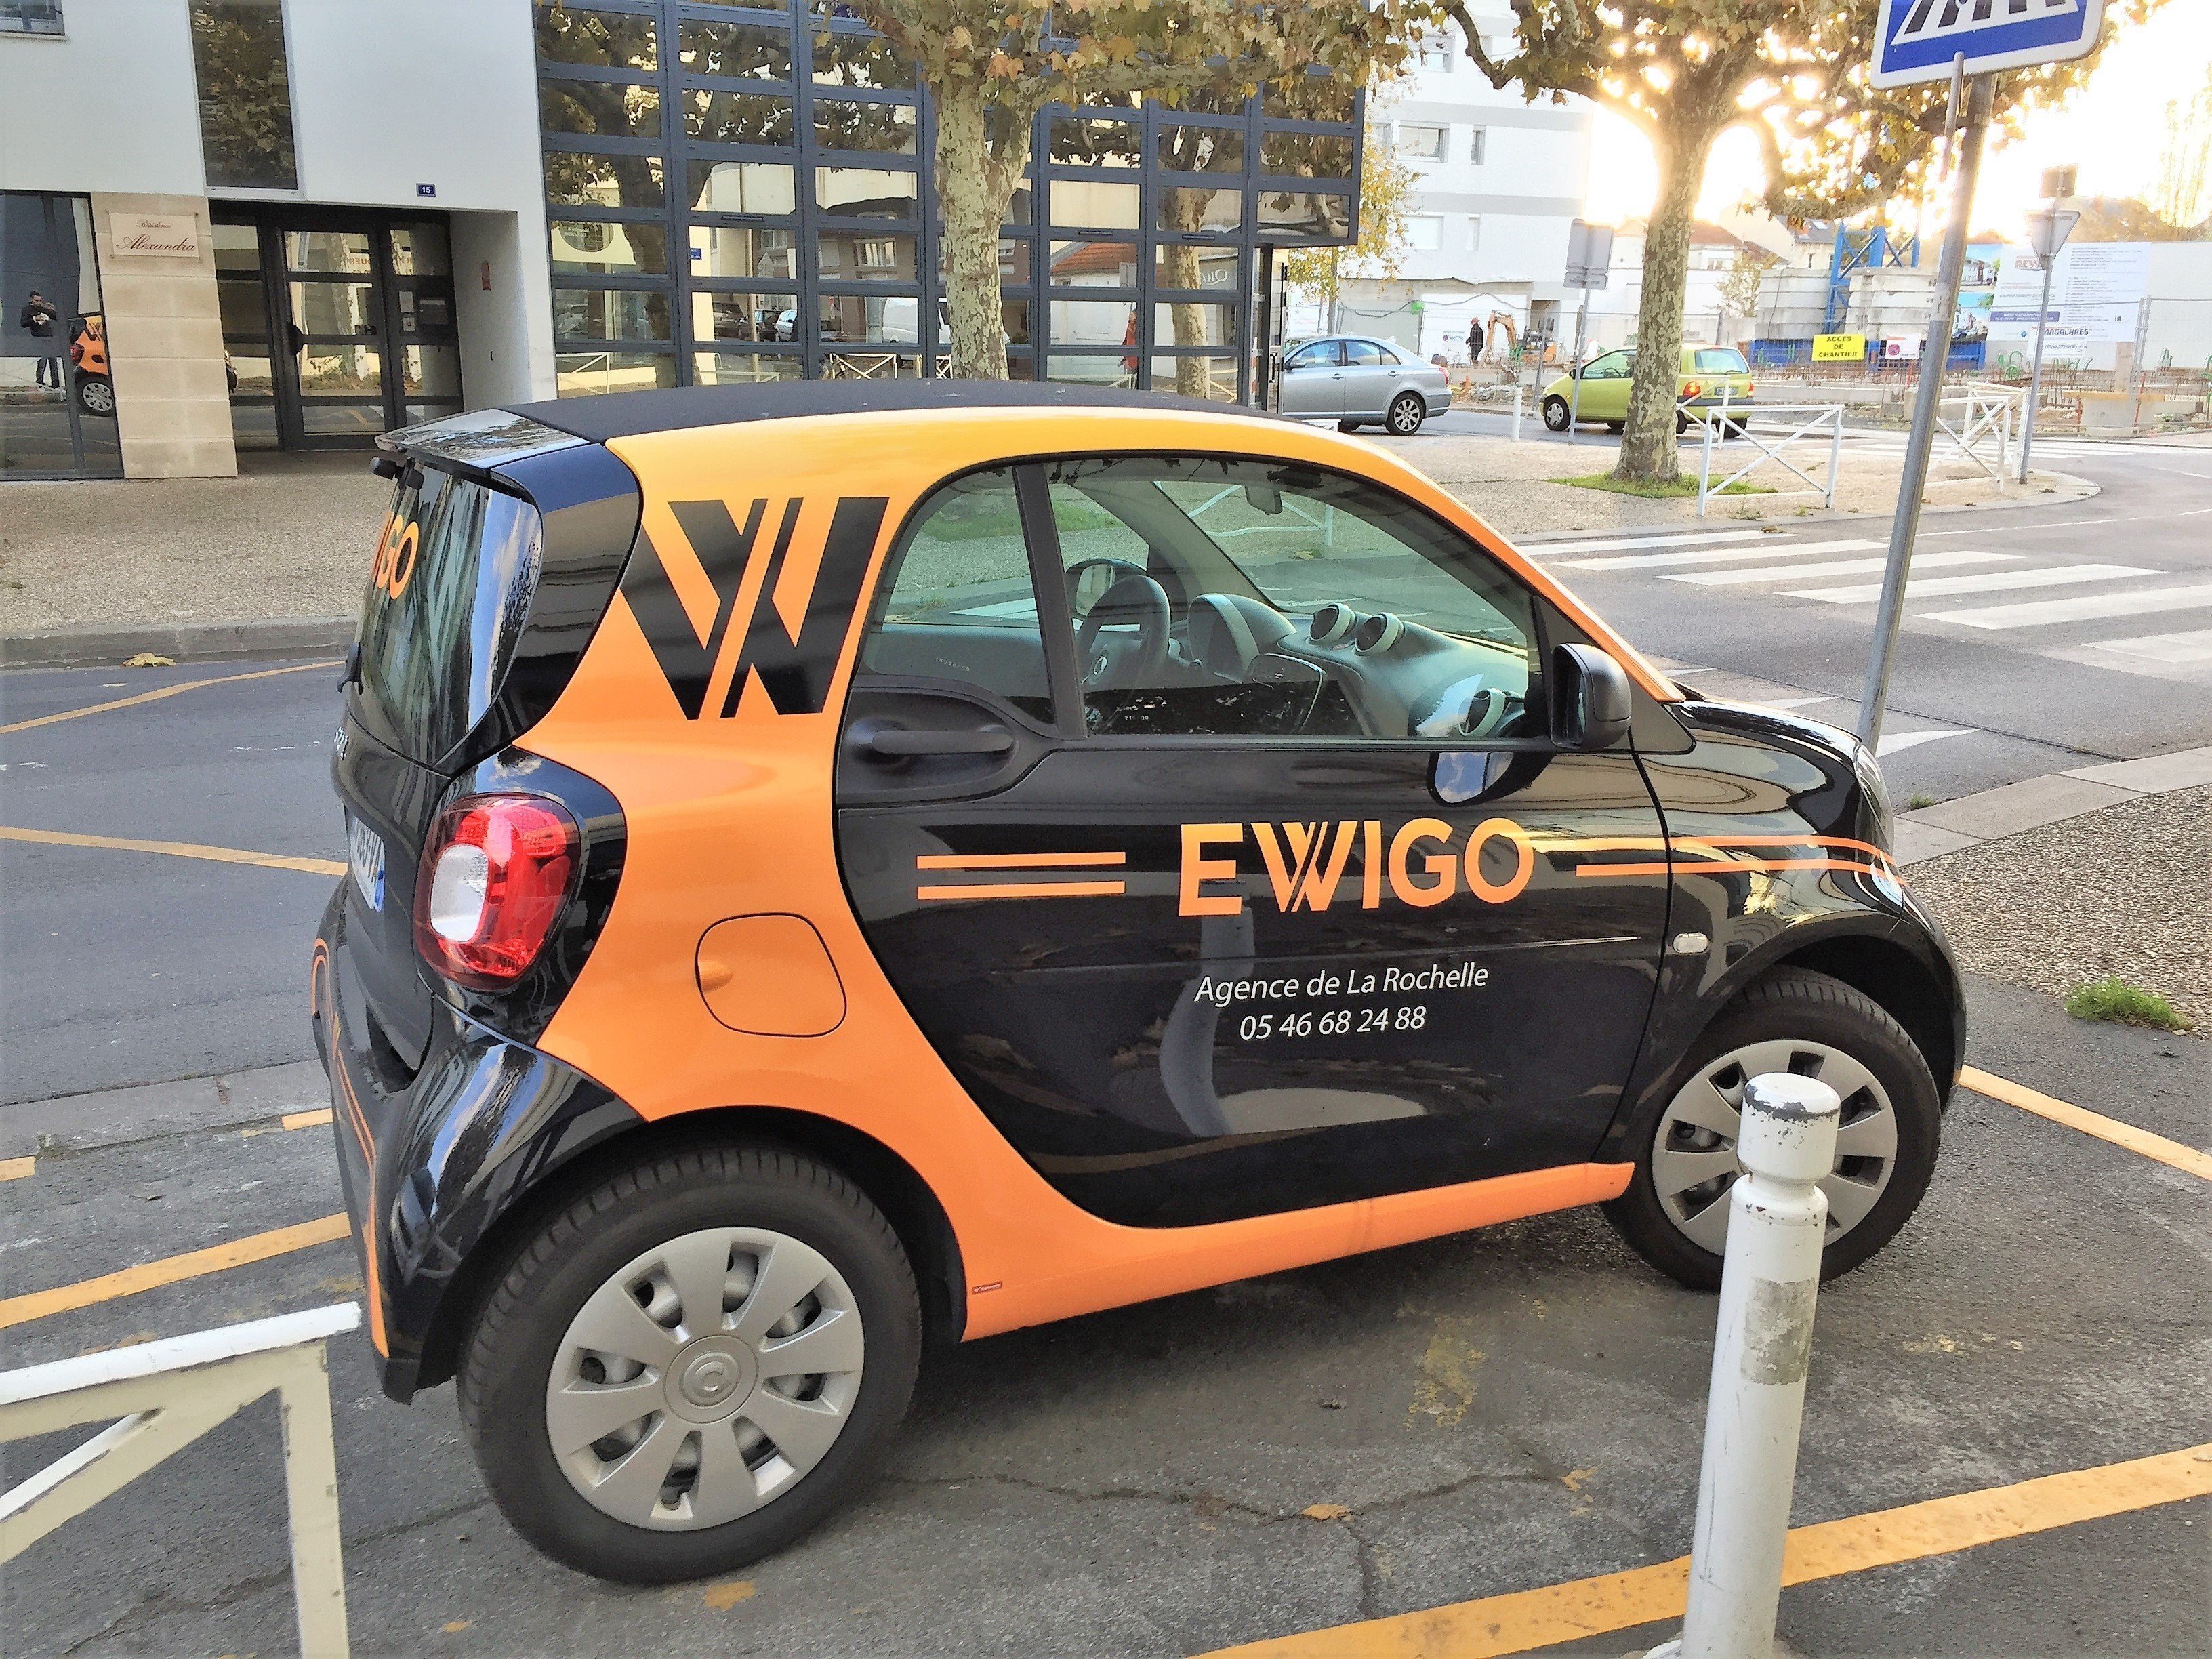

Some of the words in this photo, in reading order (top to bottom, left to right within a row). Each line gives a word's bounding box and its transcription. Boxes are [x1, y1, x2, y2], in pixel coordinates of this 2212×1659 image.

[116, 233, 195, 251] Alexandra
[1178, 817, 1534, 918] EWIGO
[1193, 975, 1299, 1008] Agence
[1306, 970, 1340, 997] de
[1347, 970, 1376, 994] La
[1382, 962, 1490, 992] Rochelle
[1239, 1015, 1273, 1040] 05
[1278, 1012, 1313, 1038] 46
[1318, 1010, 1352, 1036] 68
[1356, 1008, 1389, 1033] 24
[1394, 1006, 1427, 1030] 88
